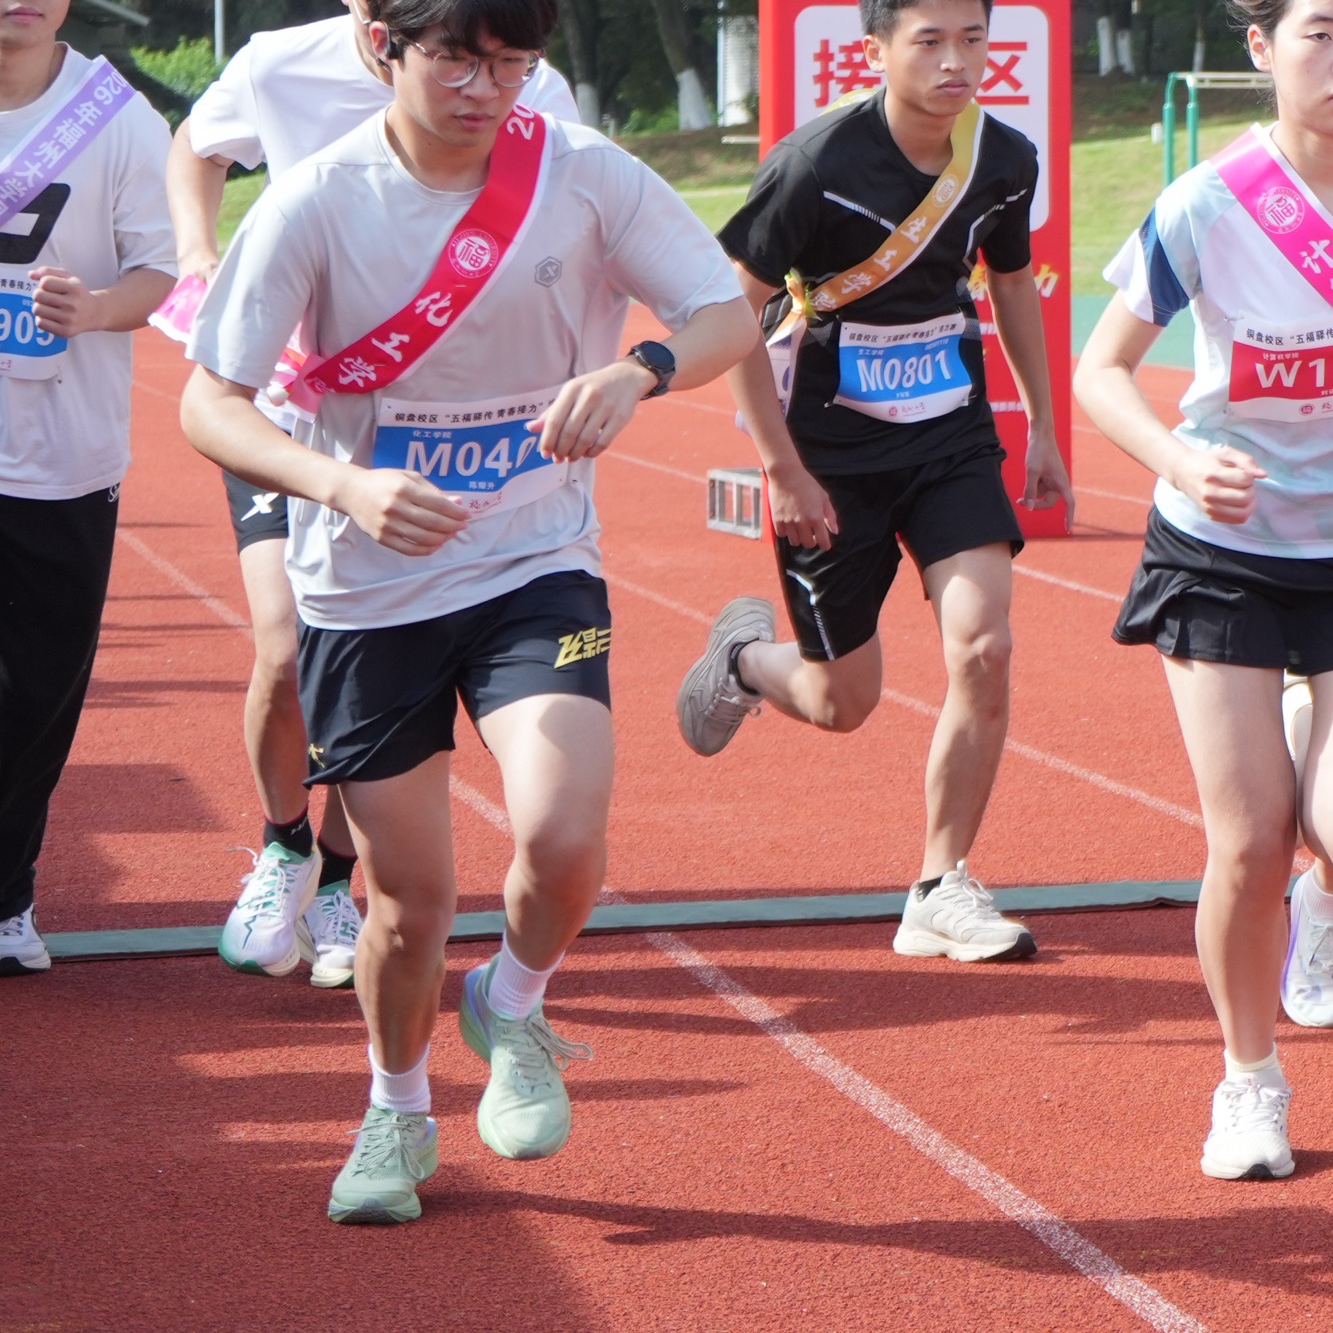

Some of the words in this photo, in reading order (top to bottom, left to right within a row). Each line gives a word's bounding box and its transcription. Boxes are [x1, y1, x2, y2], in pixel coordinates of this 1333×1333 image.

[1246, 327, 1285, 346] 铜盘校区
[856, 349, 952, 393] M0801
[394, 412, 439, 424] 铜盘校区
